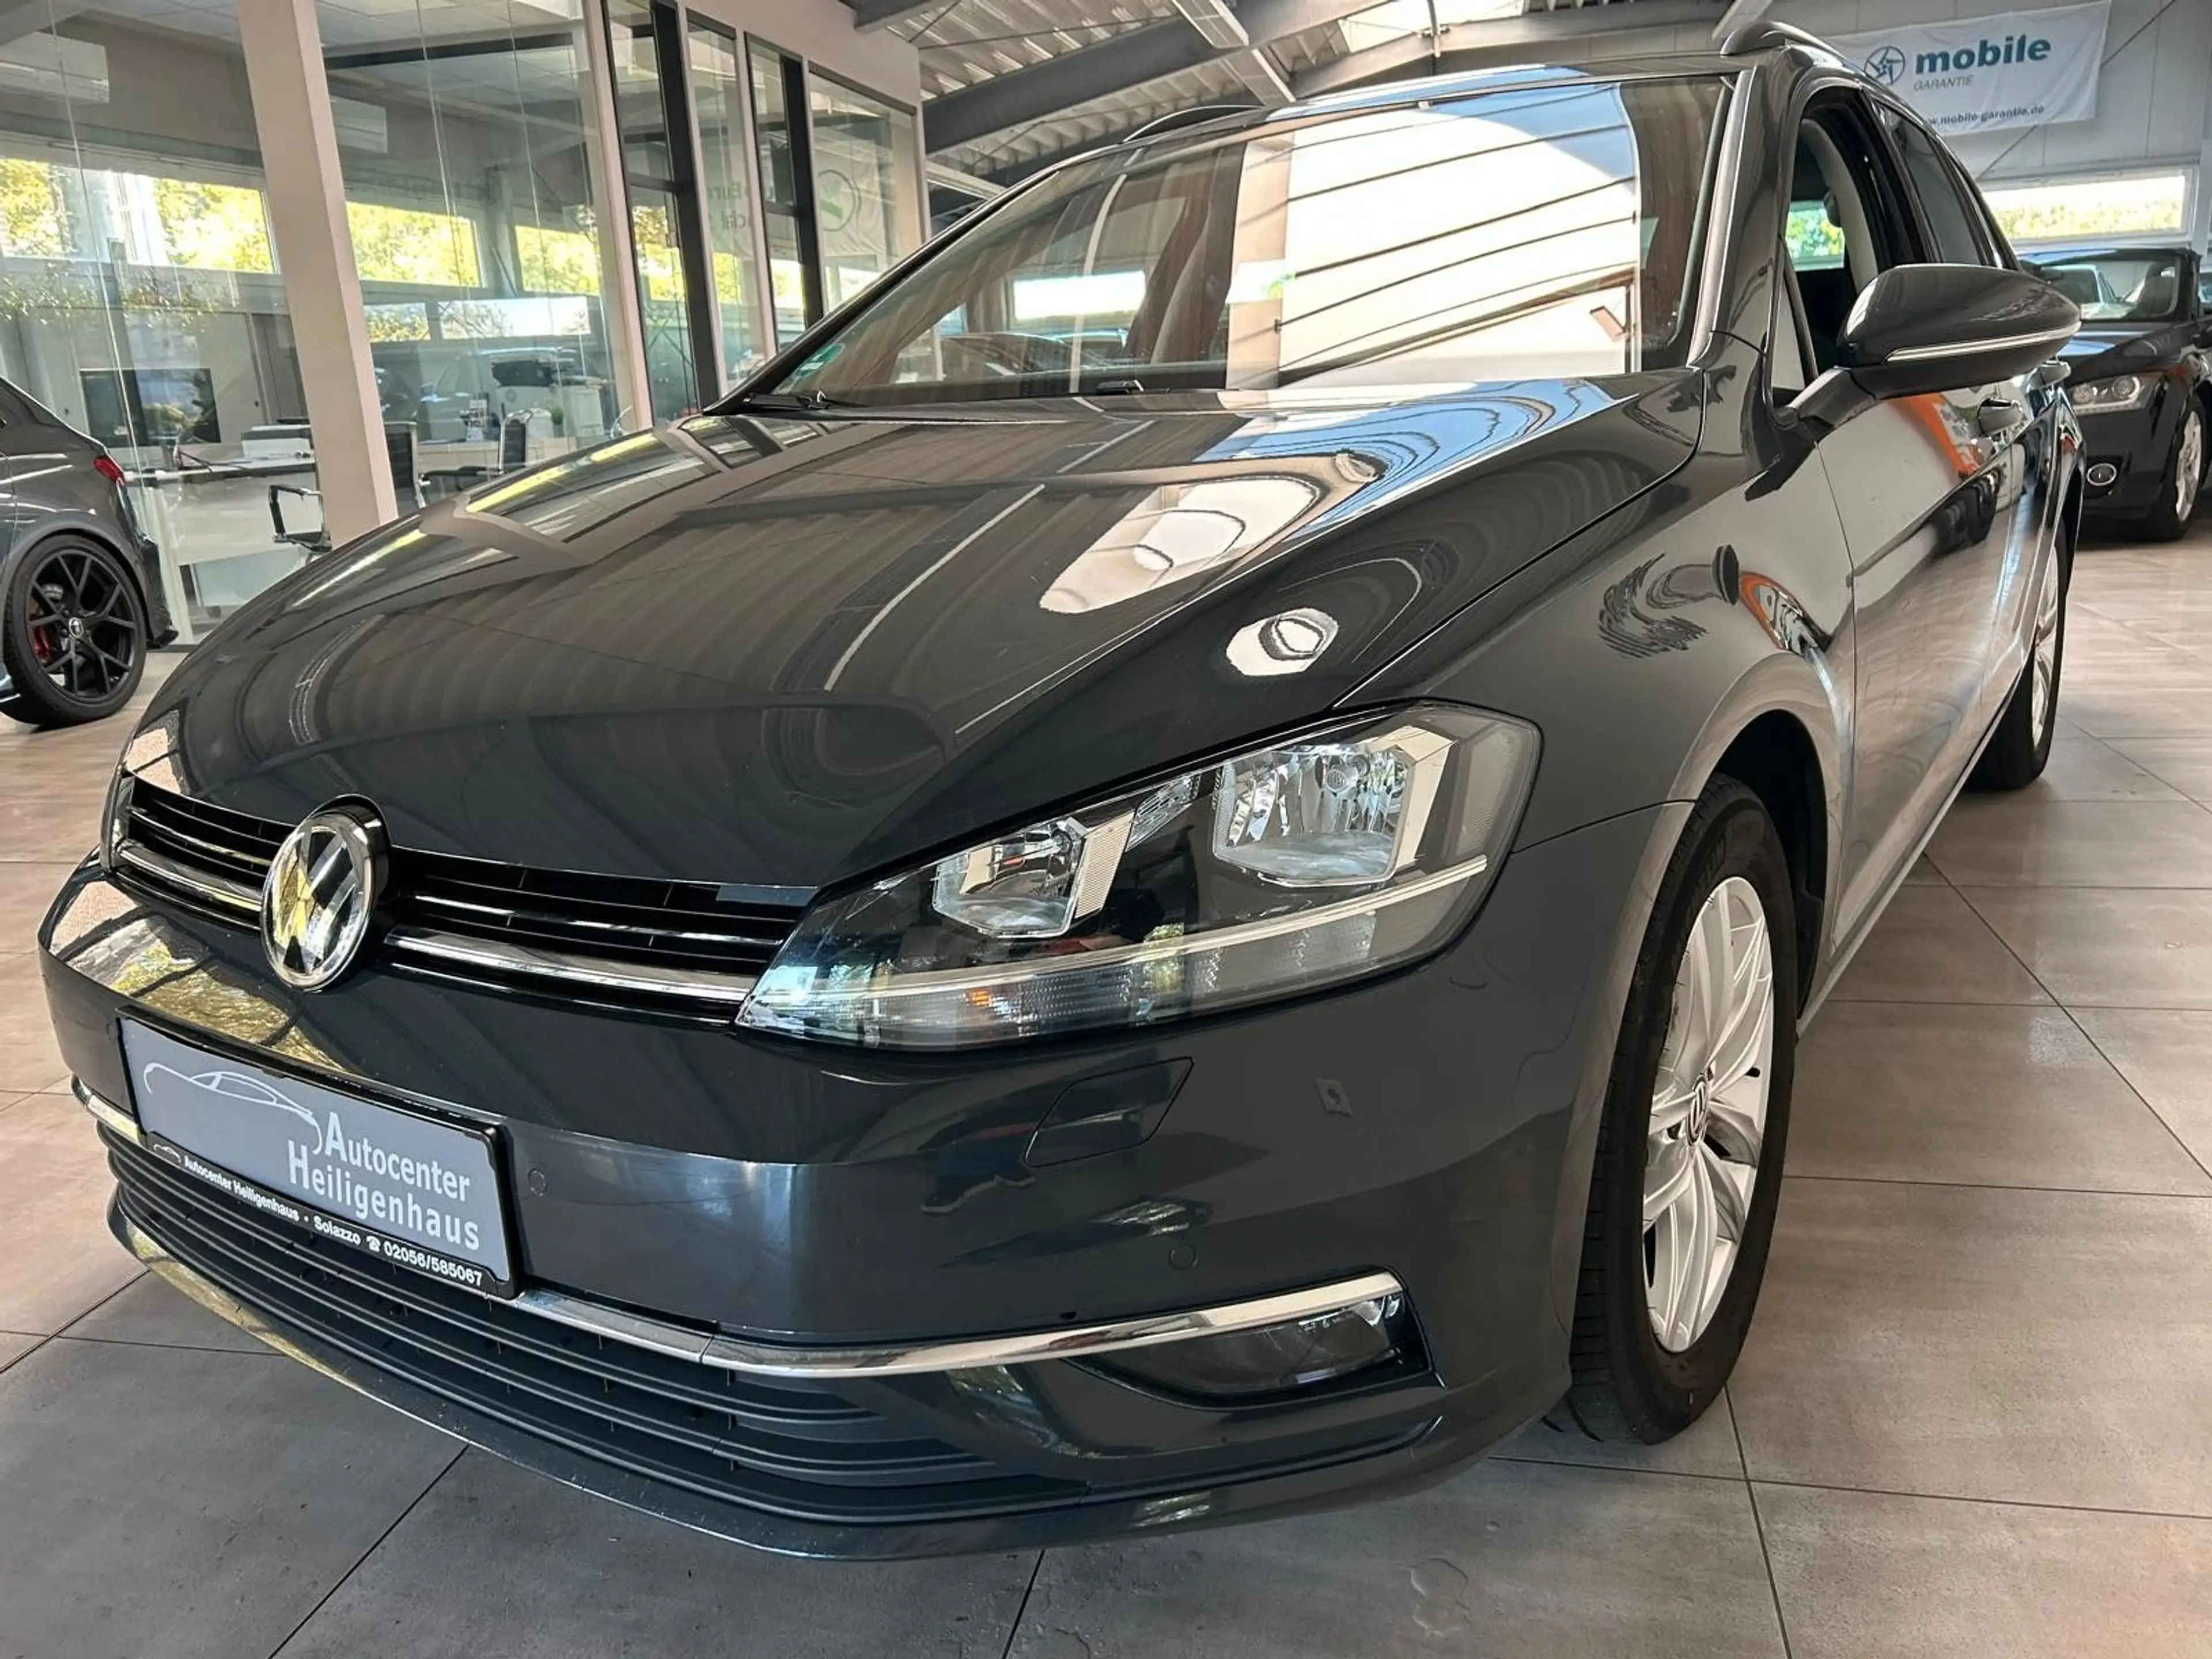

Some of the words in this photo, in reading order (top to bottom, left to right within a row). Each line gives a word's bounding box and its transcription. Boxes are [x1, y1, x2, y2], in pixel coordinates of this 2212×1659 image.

[1914, 75, 1973, 90] GARANTIE
[1915, 34, 2051, 74] mobile
[287, 1139, 480, 1251] Heiligenhaus
[324, 1111, 471, 1202] Autocenter
[183, 1154, 232, 1190] Autocenter
[232, 1179, 300, 1222] Heiligenhaus
[313, 1214, 362, 1245] Solazzo
[384, 1241, 483, 1286] 02056/585067
